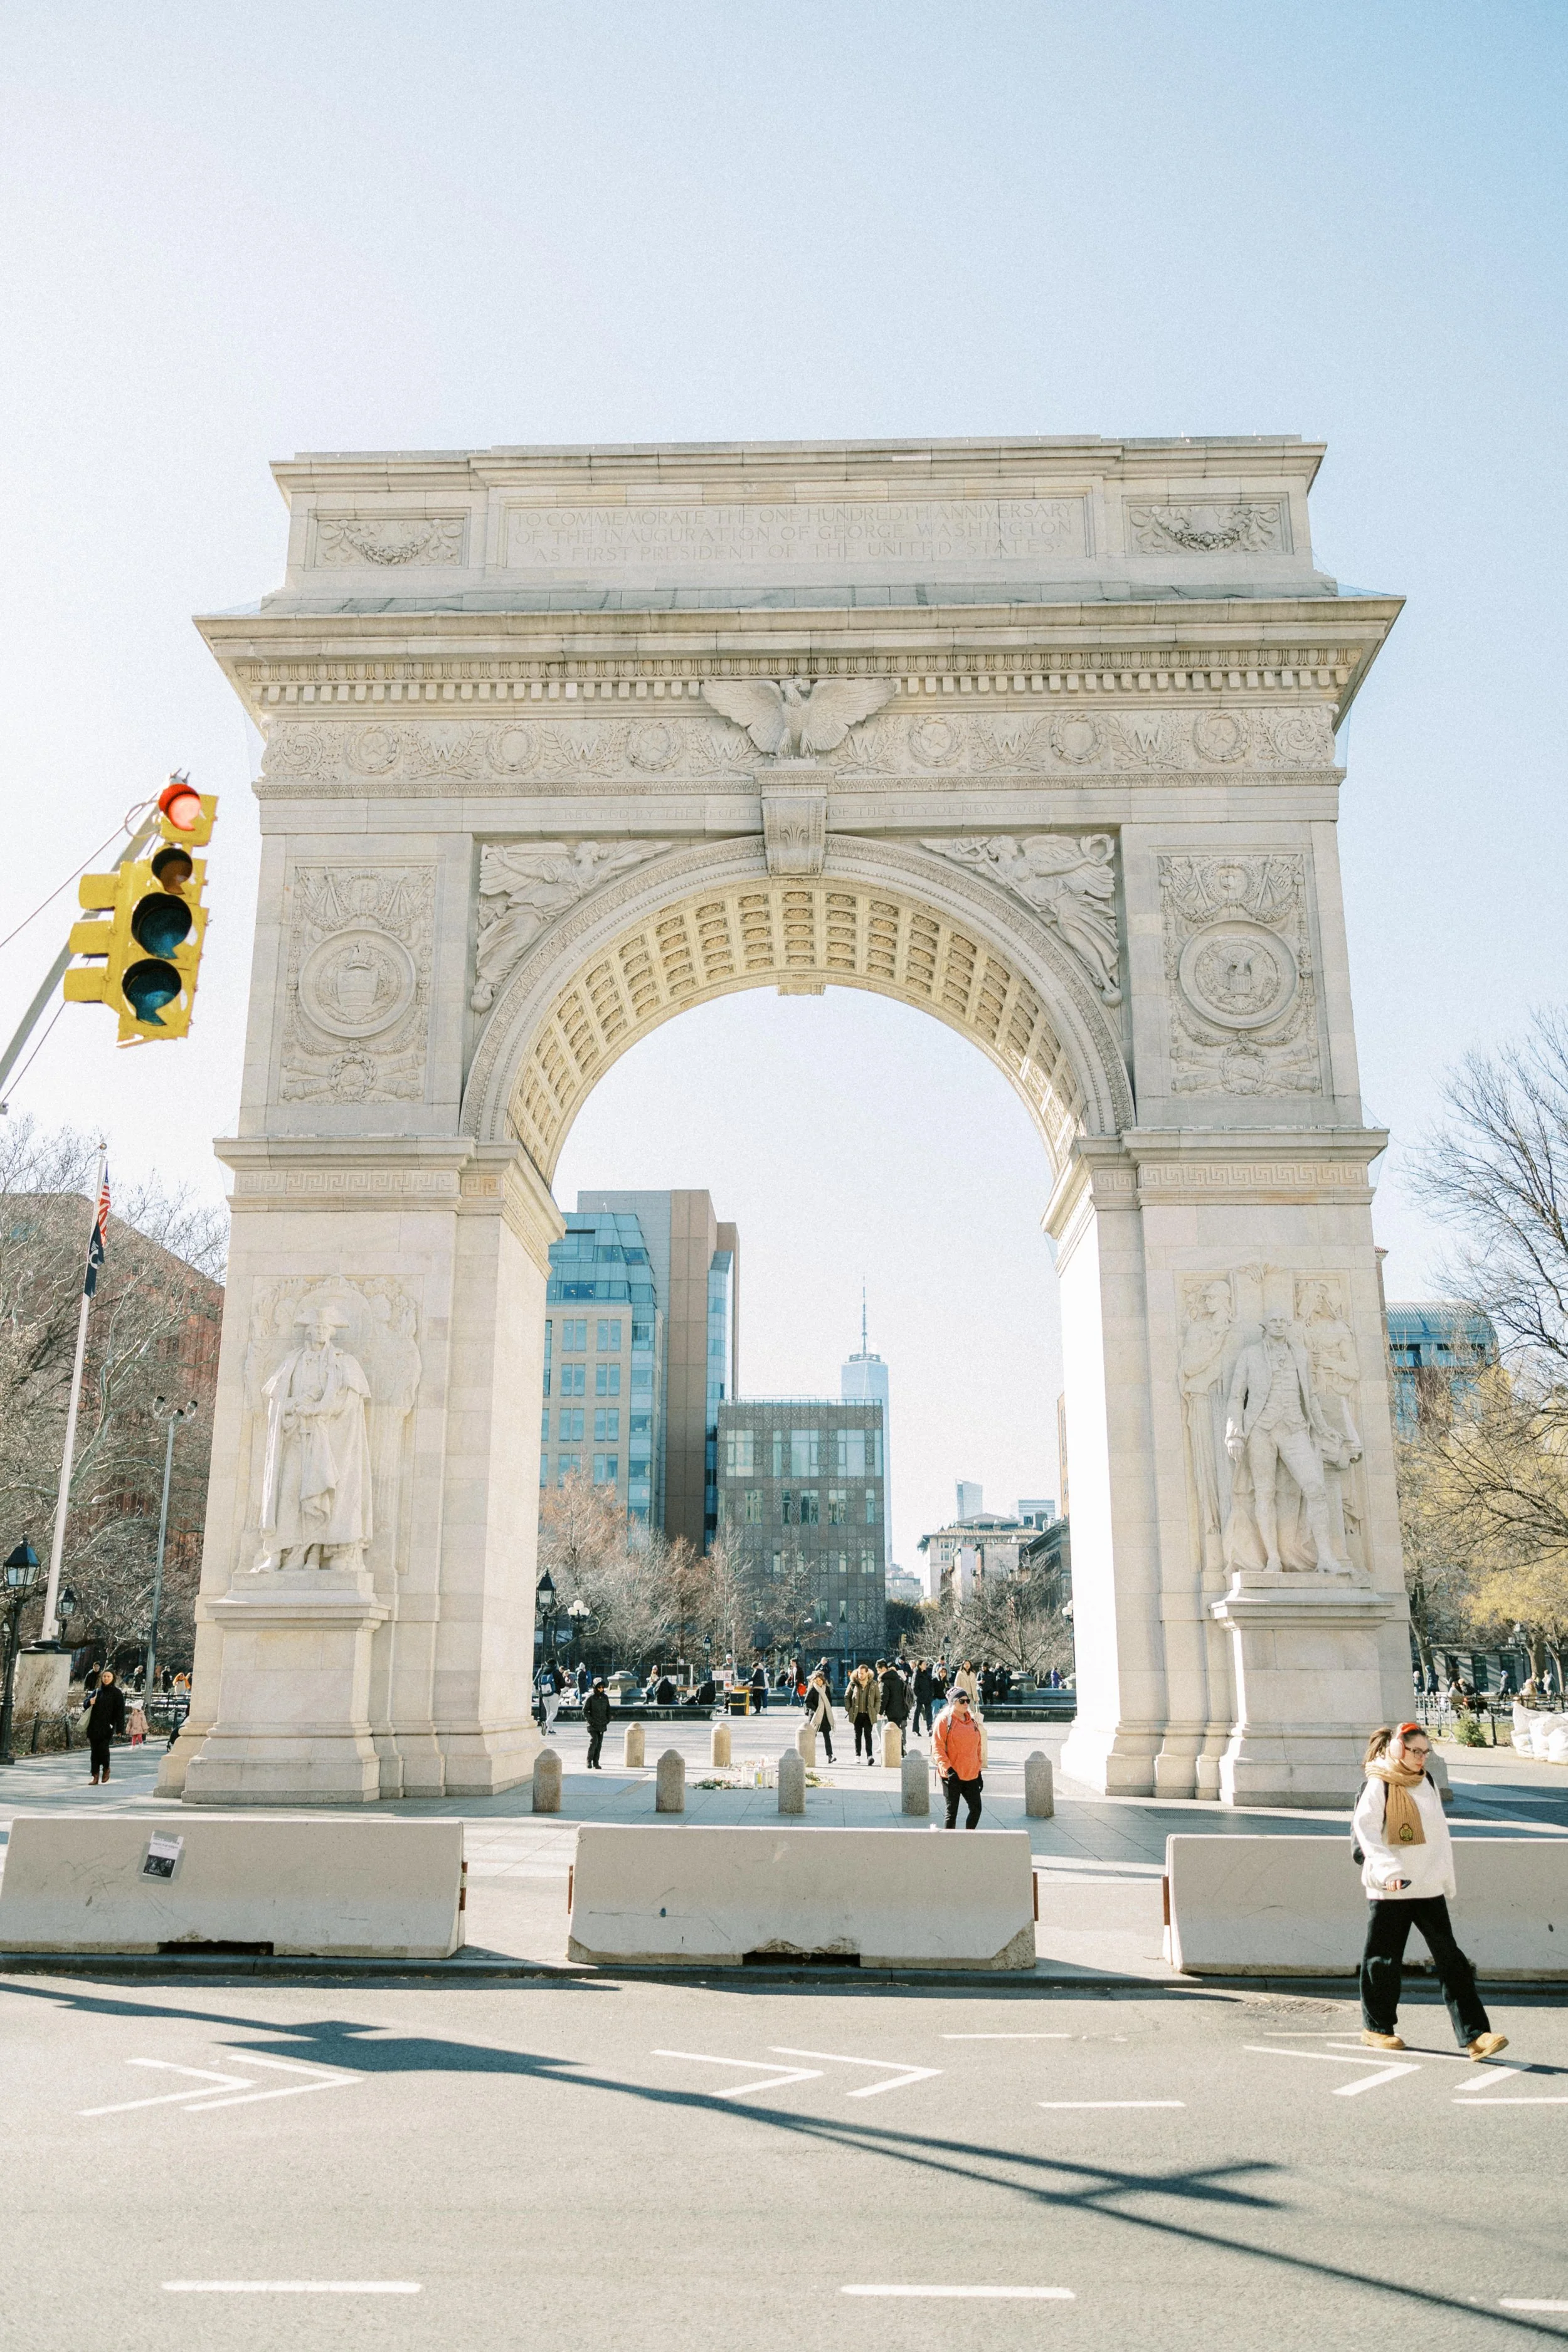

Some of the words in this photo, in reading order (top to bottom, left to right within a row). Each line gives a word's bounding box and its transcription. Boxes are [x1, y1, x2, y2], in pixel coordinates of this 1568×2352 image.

[515, 511, 542, 527] TO
[546, 509, 706, 527] COMMEMORATE
[714, 509, 754, 525] THE
[759, 507, 802, 524] ONE
[807, 505, 936, 523] HUNDREDTH
[938, 502, 1074, 520] ANNIVERSARY
[515, 529, 543, 545] OF
[552, 529, 593, 545] THE
[604, 526, 770, 544] INAUGURATION
[781, 525, 809, 541] OF
[818, 523, 904, 539] GEORGE
[916, 520, 1072, 538] WASHINGTON
[534, 548, 561, 563] AS
[571, 546, 632, 563] FIRST
[640, 544, 761, 561] PRESIDENT
[768, 543, 797, 559] OF
[814, 541, 857, 558] THE
[867, 539, 952, 556] UNITED
[430, 740, 459, 761] W
[569, 738, 600, 760] W
[710, 736, 742, 759] W
[850, 733, 879, 759] W
[992, 731, 1020, 753] W
[1135, 728, 1160, 753] W
